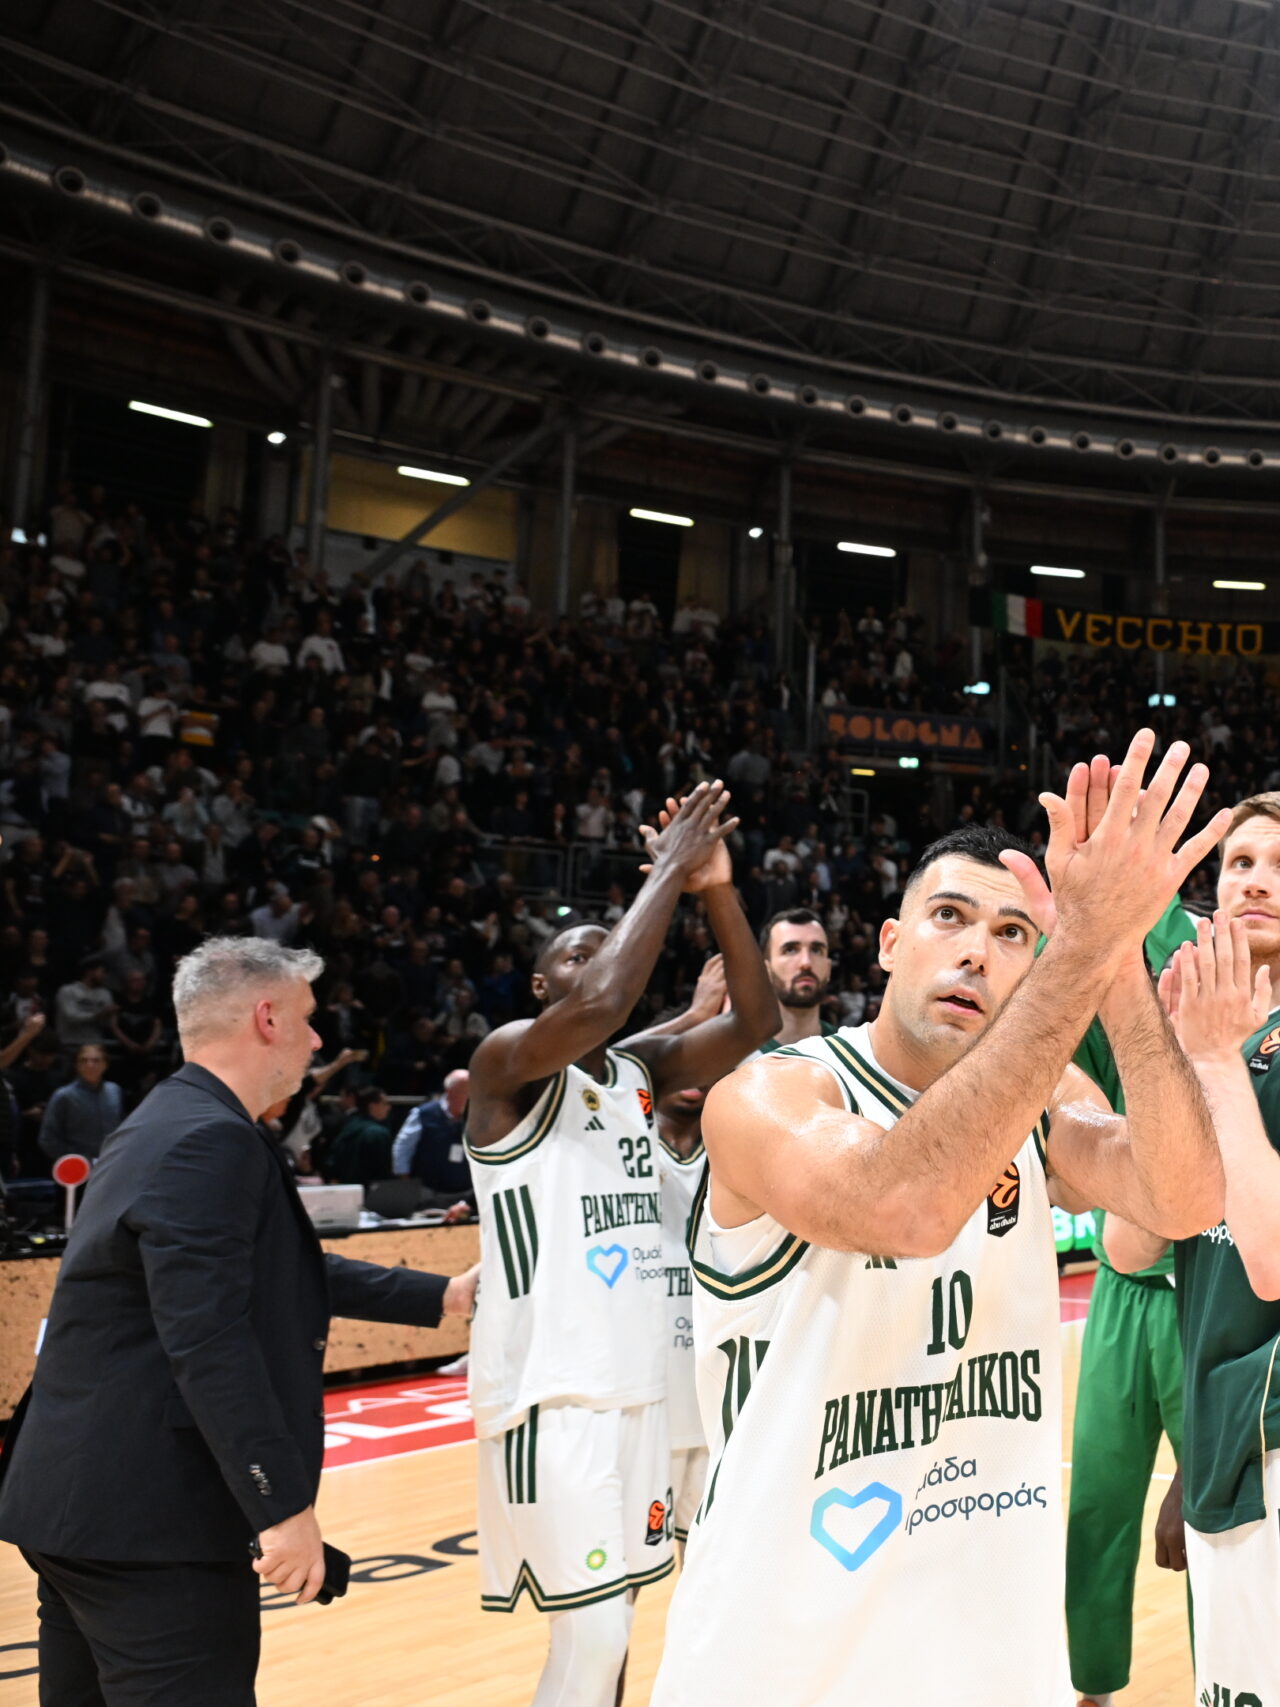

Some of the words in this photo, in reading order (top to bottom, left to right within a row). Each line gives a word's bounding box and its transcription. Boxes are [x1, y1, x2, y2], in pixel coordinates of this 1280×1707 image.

[1055, 607, 1264, 656] VECCHIO
[827, 713, 984, 750] BOLOGNA
[618, 1136, 653, 1178] 22
[927, 1270, 973, 1356] 10
[905, 1482, 1048, 1535] ροσφοράς
